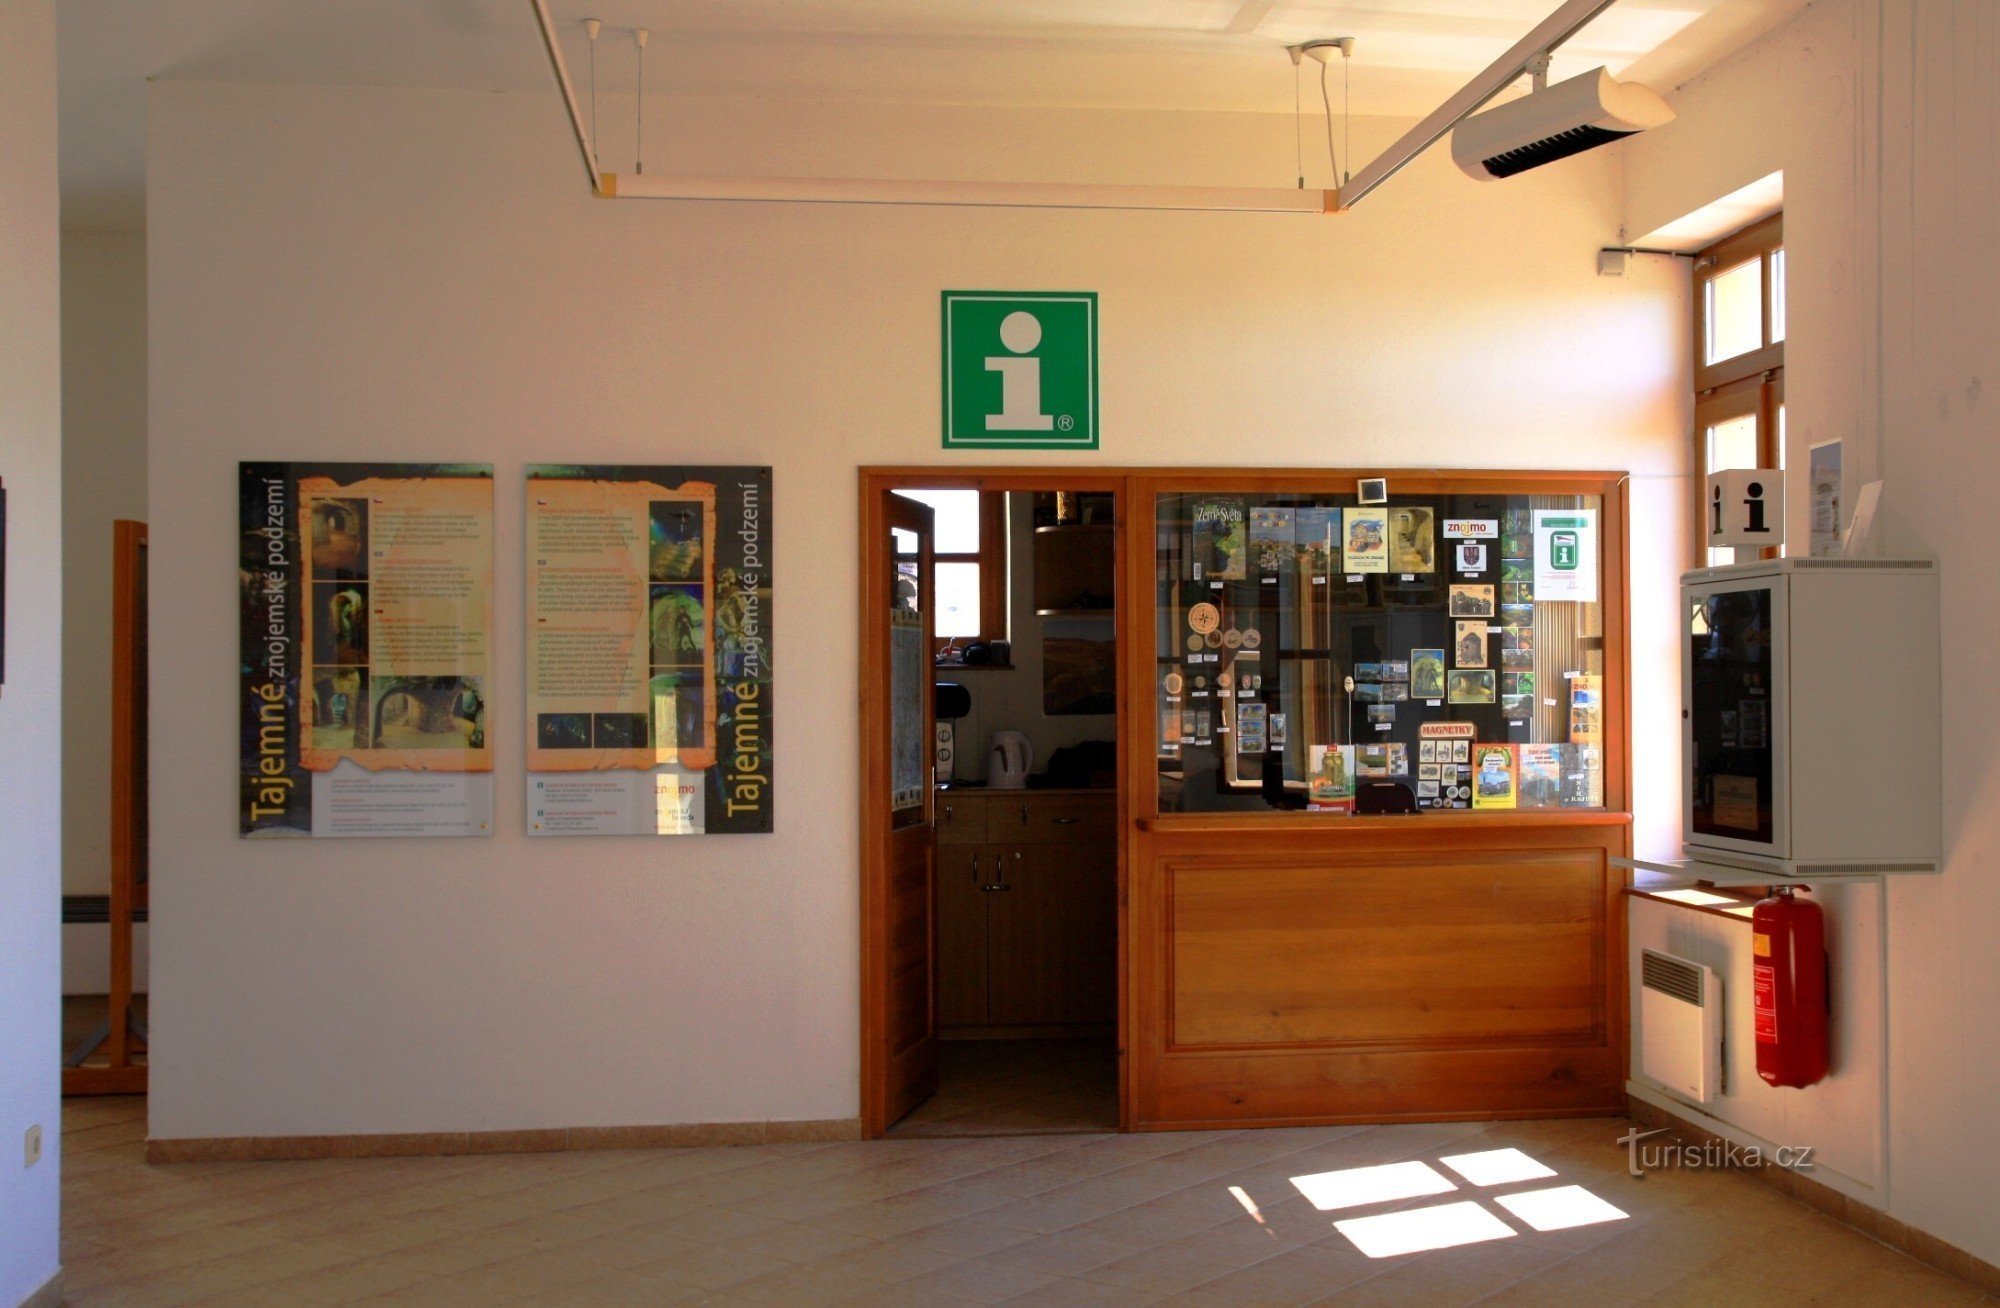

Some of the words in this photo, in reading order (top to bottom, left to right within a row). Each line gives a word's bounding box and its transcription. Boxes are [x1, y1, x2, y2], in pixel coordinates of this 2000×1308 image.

[262, 478, 290, 566] podzemí
[738, 482, 763, 568] podzemí
[1448, 521, 1486, 533] znojmo
[262, 572, 290, 678] znojemské
[738, 573, 763, 678] znojemské
[251, 682, 294, 821] Tajemné
[727, 682, 767, 818] Tajemné
[1422, 725, 1472, 735] MAGNETKY
